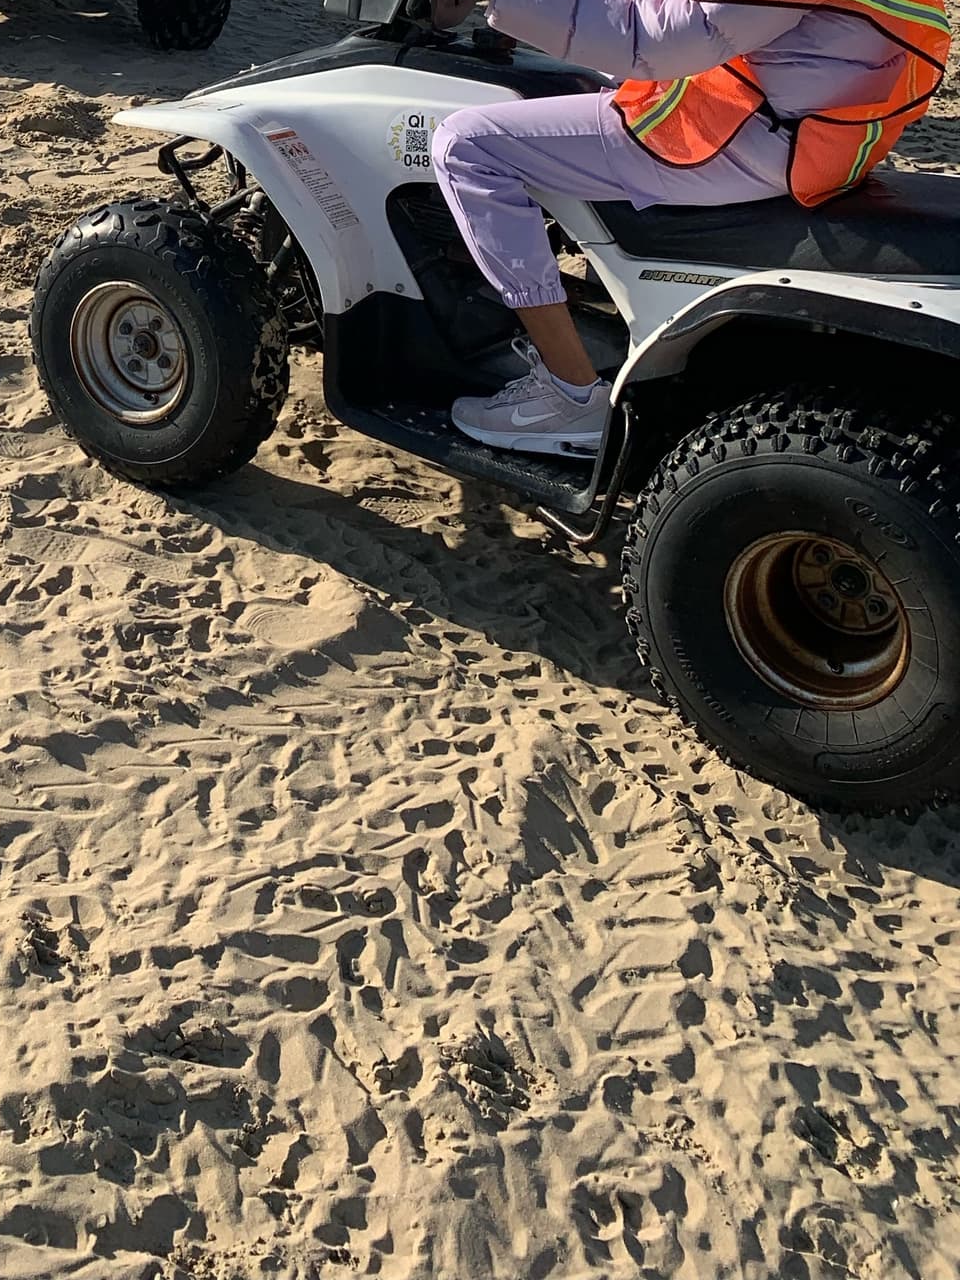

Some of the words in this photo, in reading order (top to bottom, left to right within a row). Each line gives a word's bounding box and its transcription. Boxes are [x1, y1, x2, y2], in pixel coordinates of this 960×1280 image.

[408, 115, 425, 128] QI
[403, 153, 430, 167] 048
[639, 270, 726, 287] AUTOMAT
